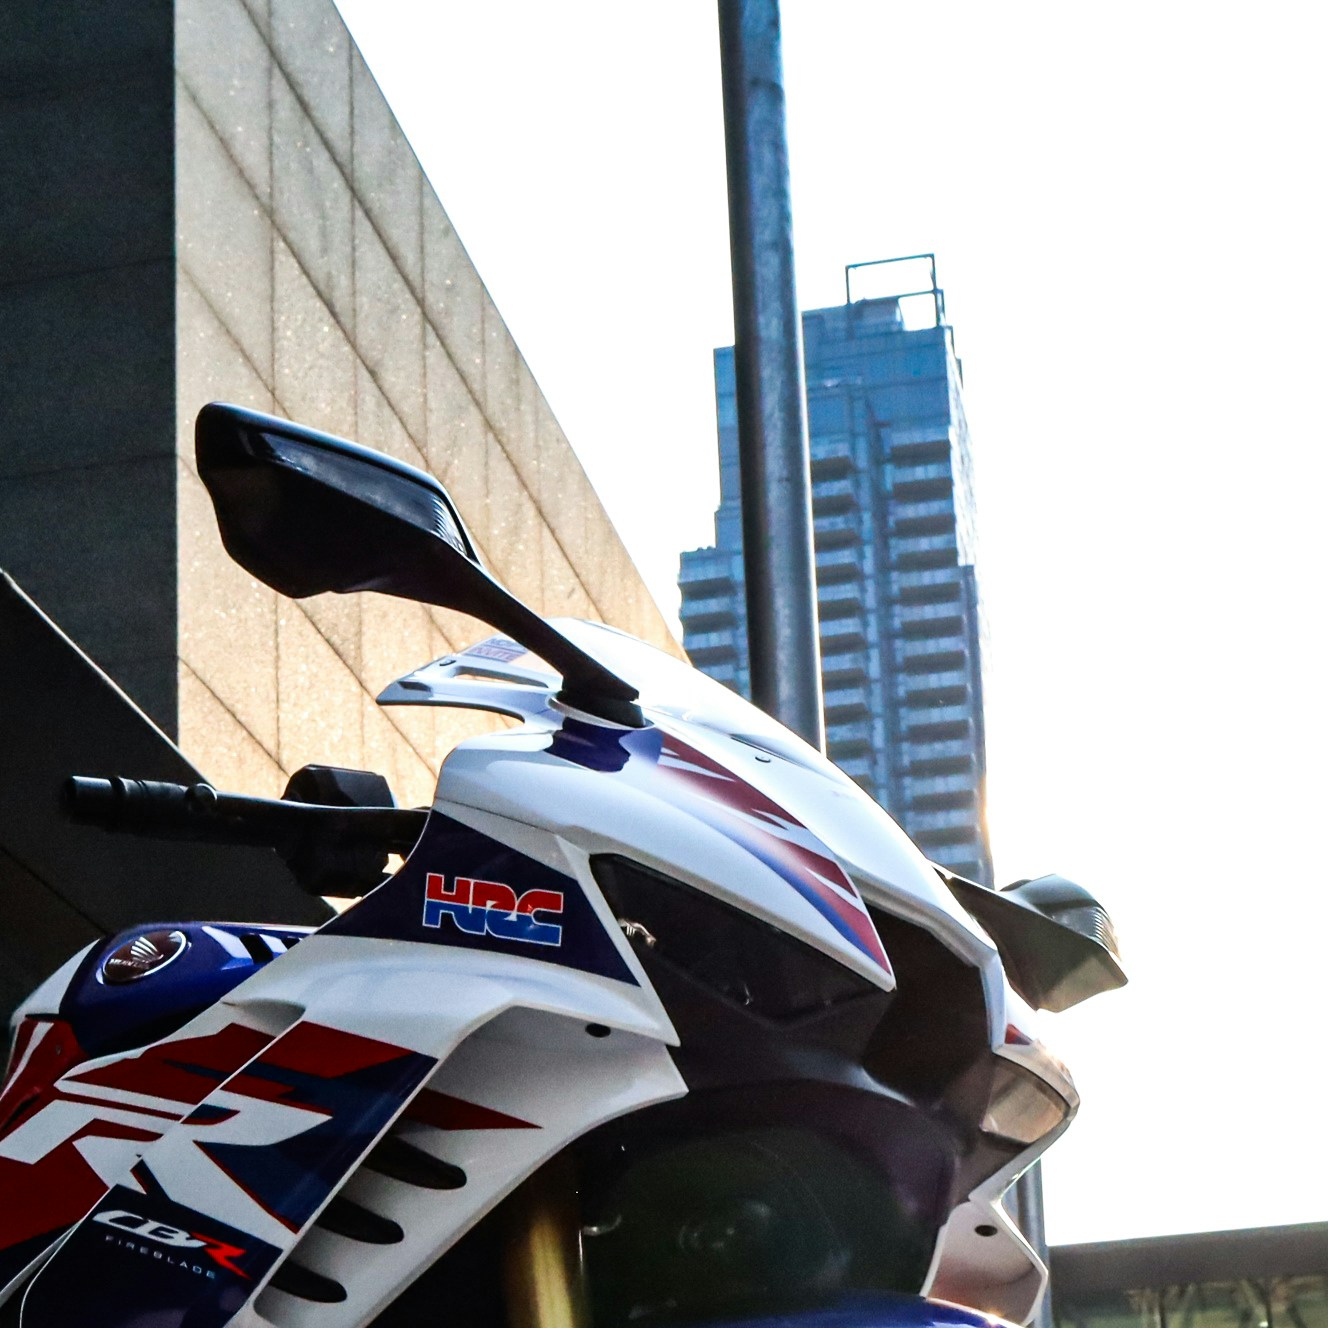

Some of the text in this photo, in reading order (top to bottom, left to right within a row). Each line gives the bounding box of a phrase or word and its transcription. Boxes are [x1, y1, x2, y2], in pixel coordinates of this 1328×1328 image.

[422, 872, 564, 947] HRC
[92, 1209, 253, 1280] CBR
[104, 1234, 217, 1280] FIREBLADE
